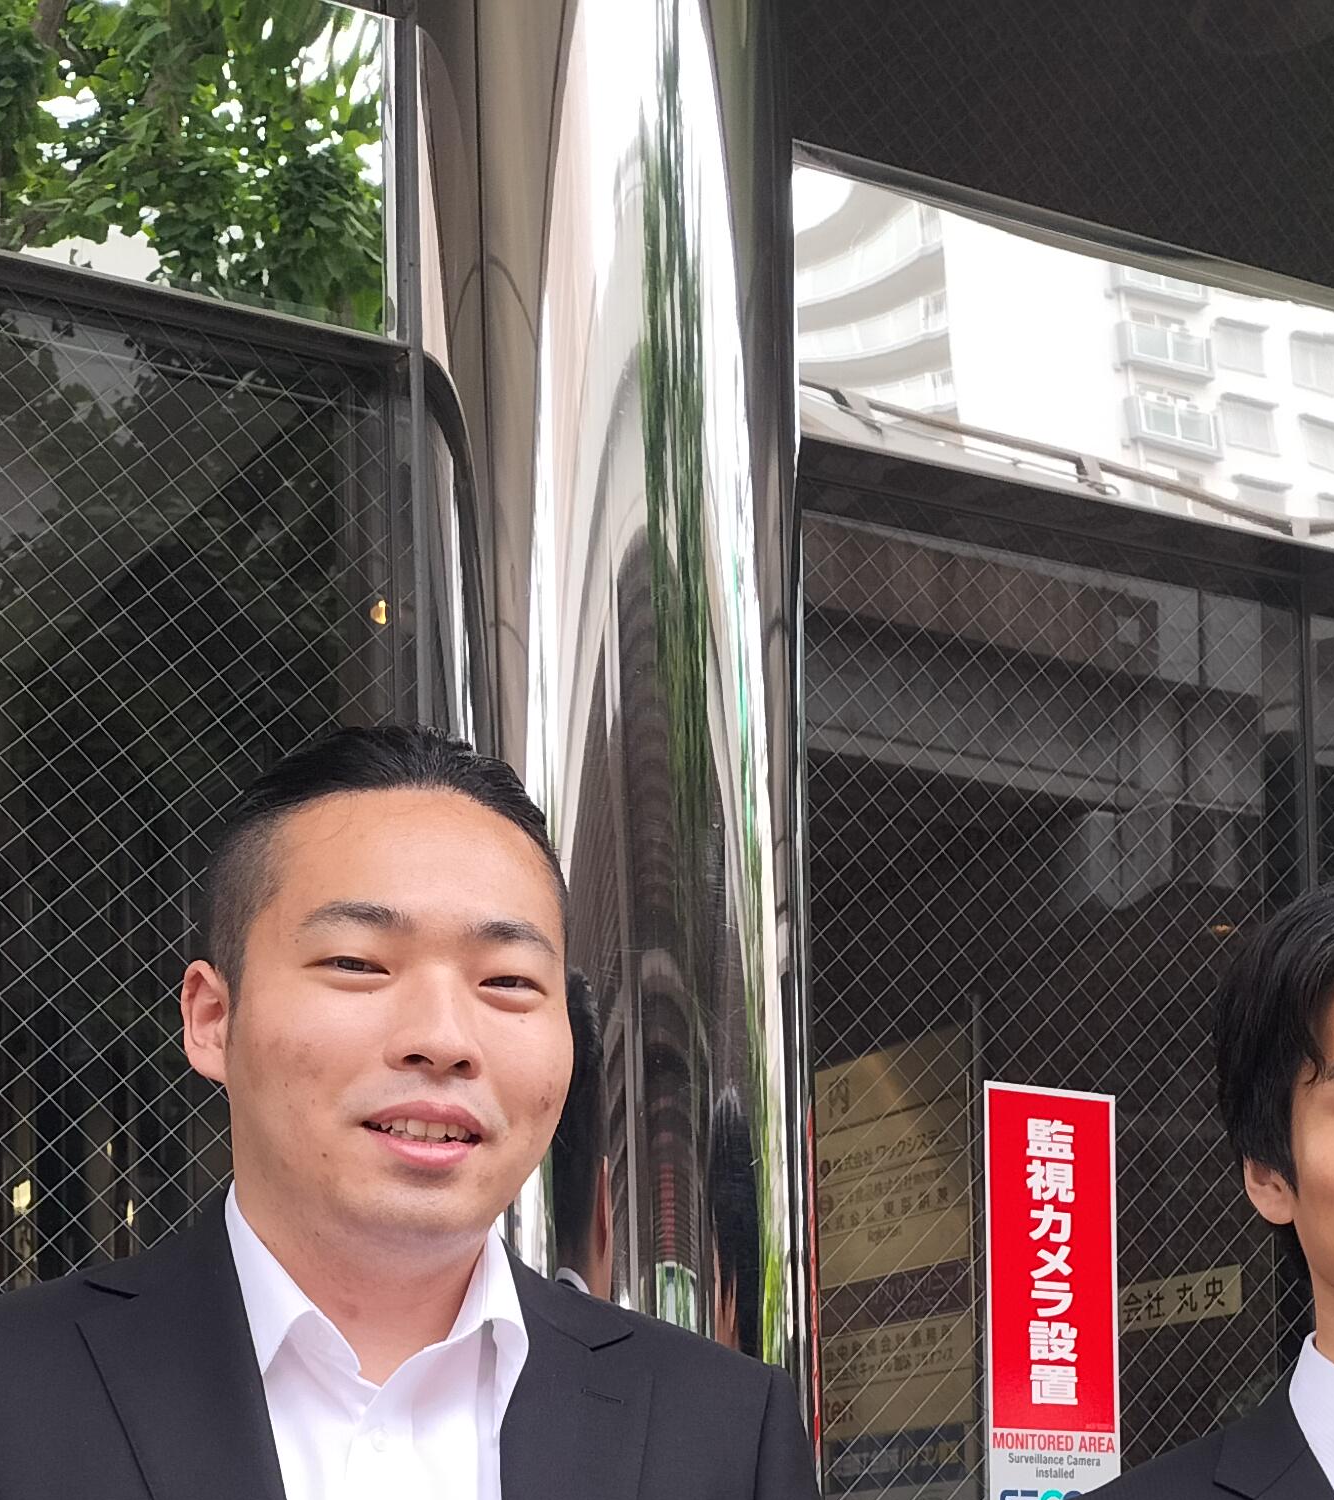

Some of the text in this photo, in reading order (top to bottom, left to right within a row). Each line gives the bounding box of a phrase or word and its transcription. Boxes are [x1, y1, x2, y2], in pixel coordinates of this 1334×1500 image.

[1026, 1117, 1078, 1406] 監視カメラ設置
[992, 1432, 1115, 1454] MONITORED AREA
[1008, 1453, 1101, 1467] Surveillance Camera
[1035, 1468, 1075, 1479] installed
